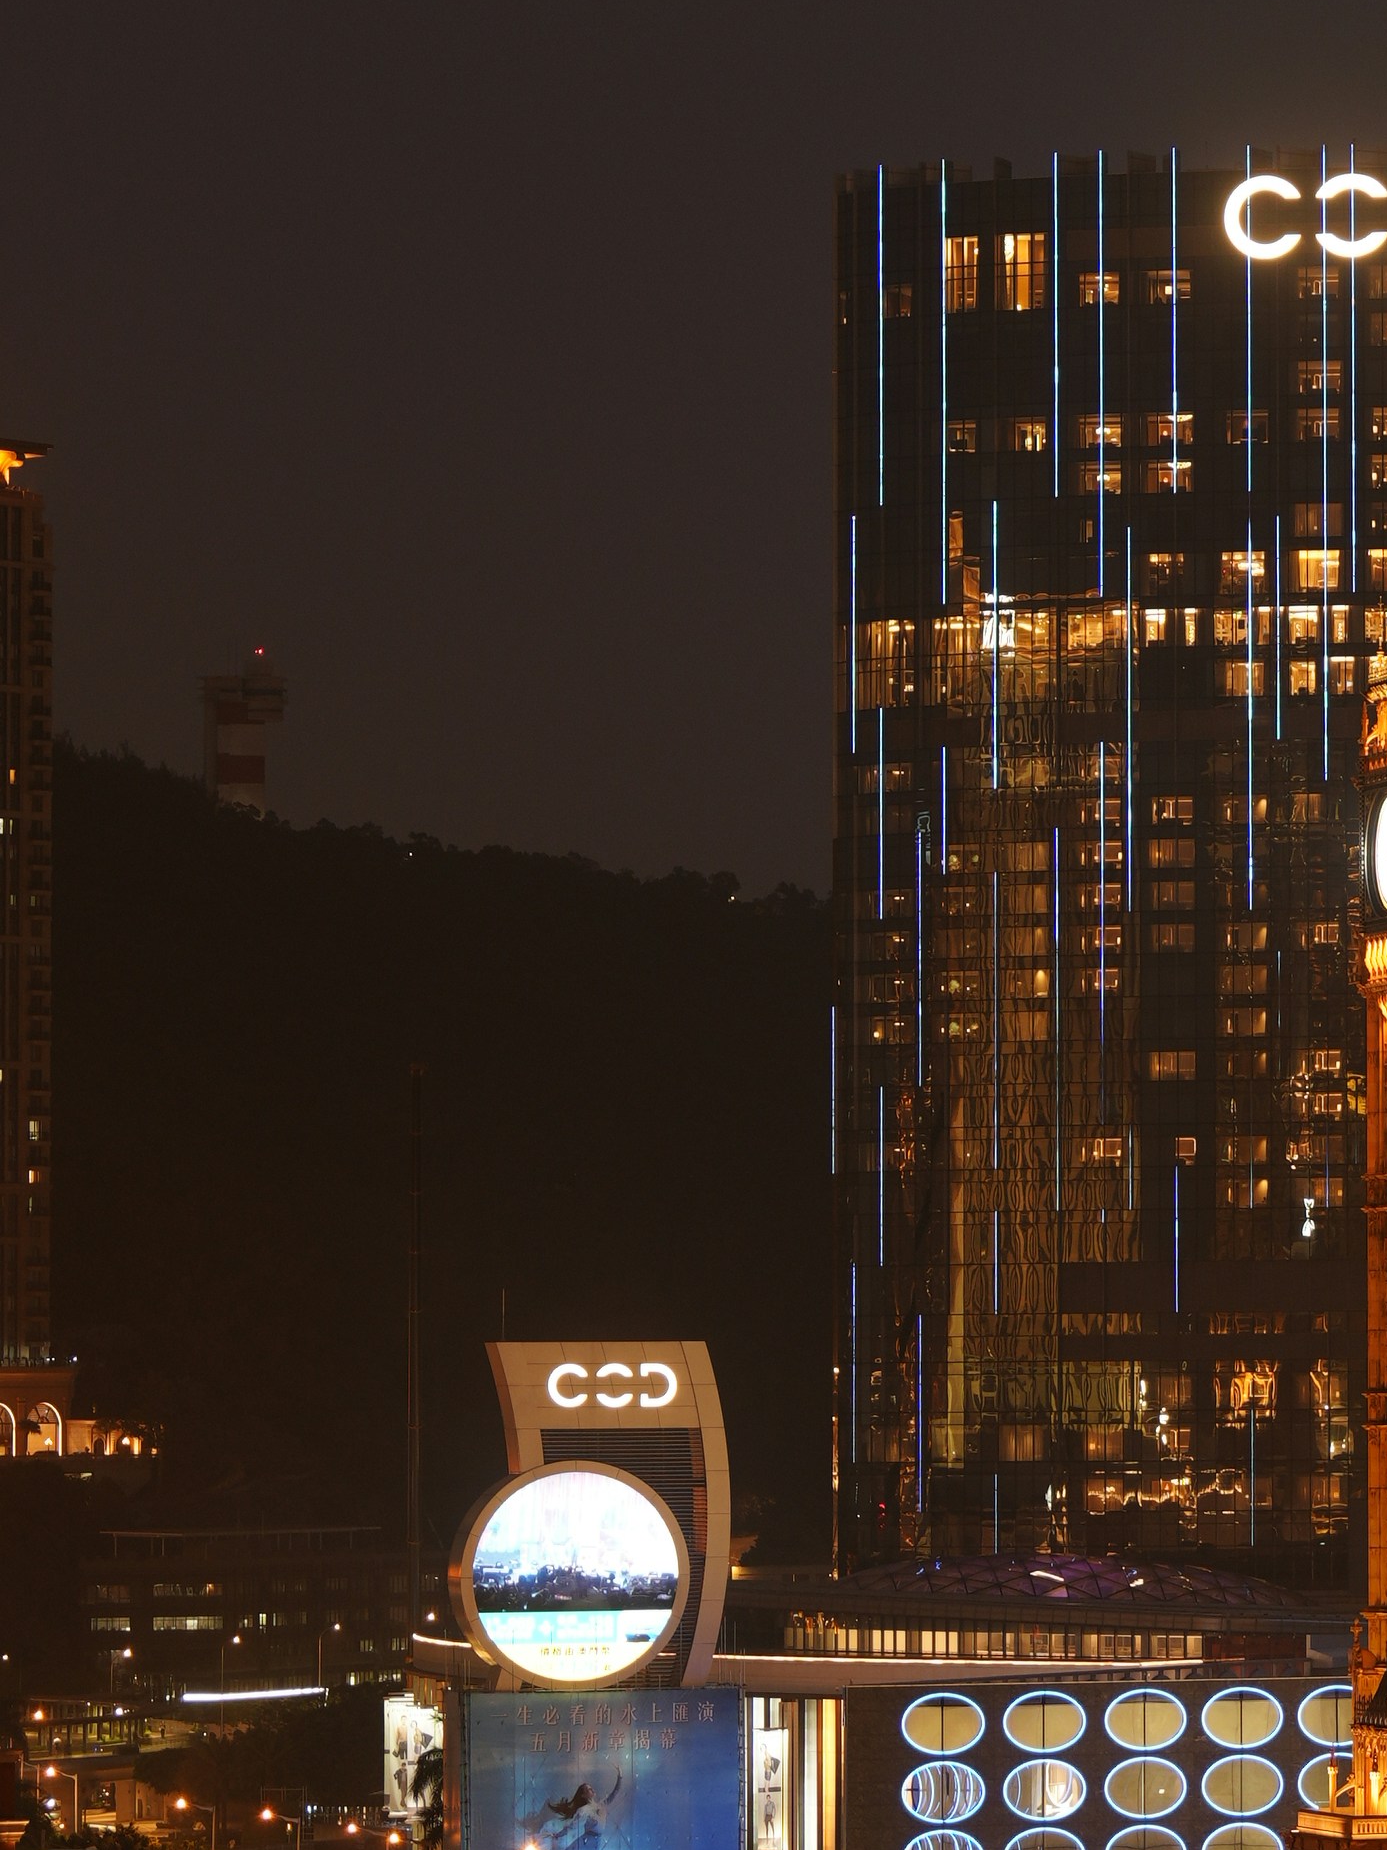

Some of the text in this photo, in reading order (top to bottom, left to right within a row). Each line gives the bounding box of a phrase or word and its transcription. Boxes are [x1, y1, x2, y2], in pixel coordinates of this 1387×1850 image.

[491, 1701, 715, 1727] 一生必看的水上匯演
[530, 1728, 678, 1753] 五月新章揭幕
